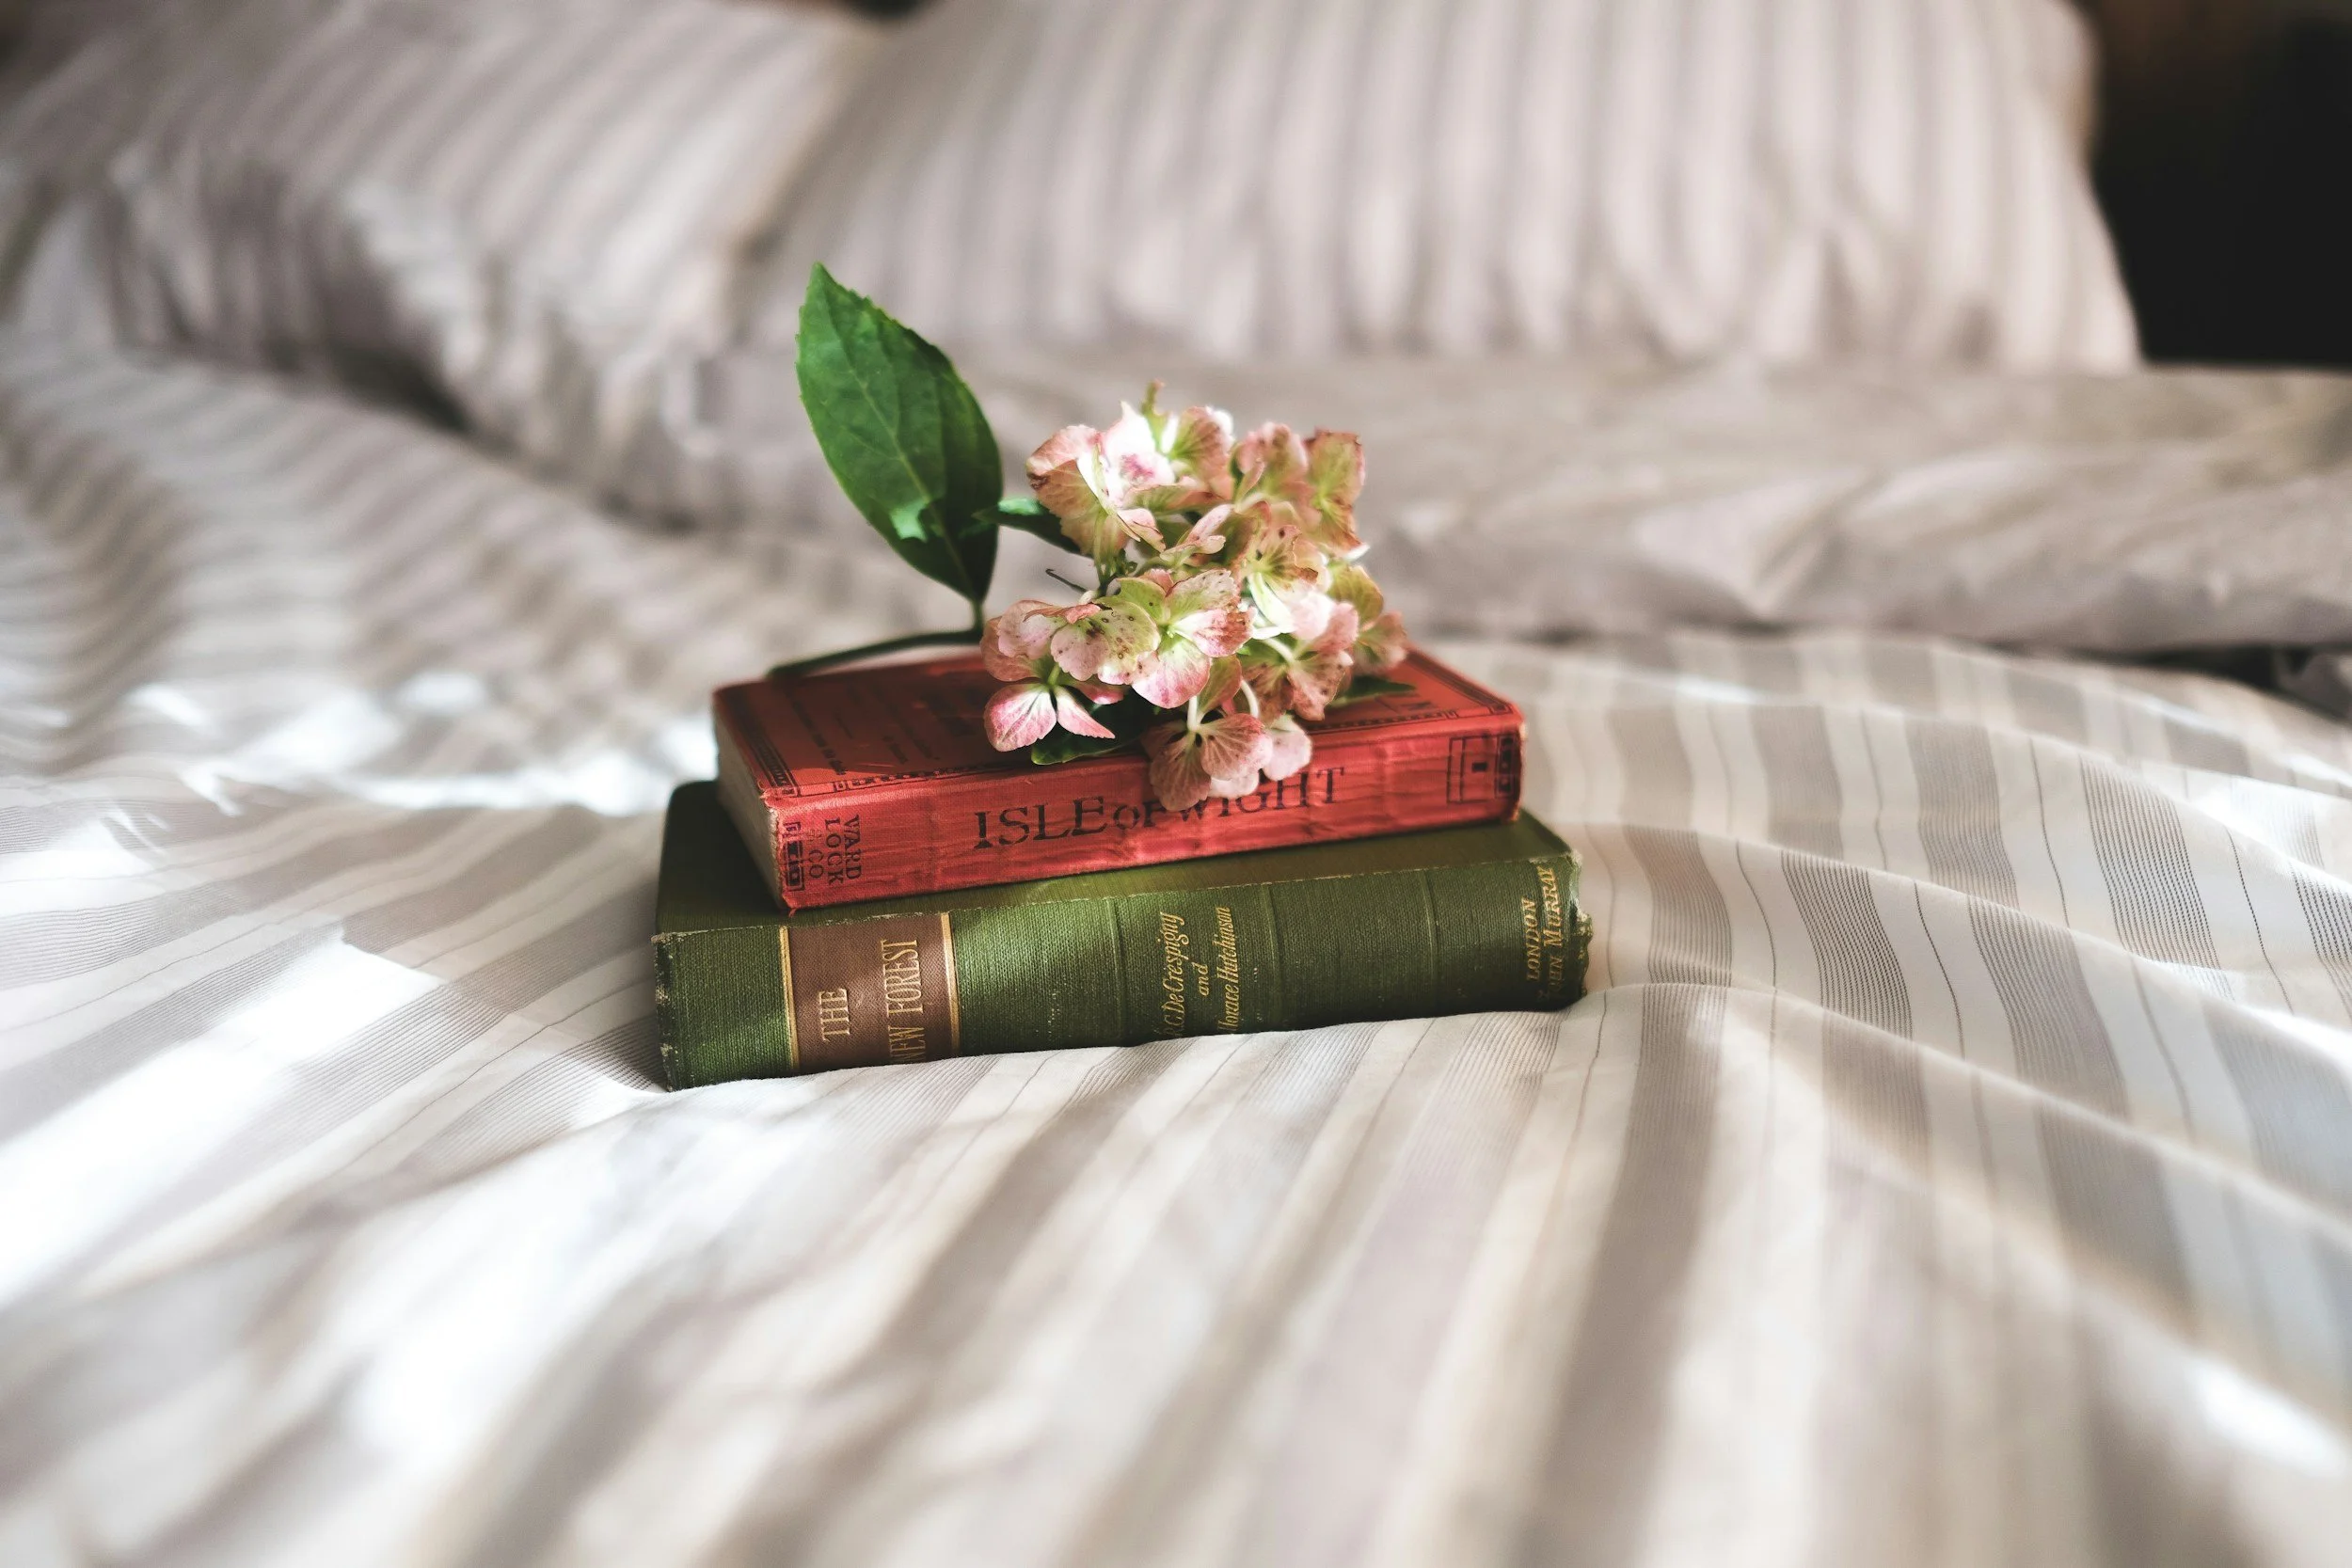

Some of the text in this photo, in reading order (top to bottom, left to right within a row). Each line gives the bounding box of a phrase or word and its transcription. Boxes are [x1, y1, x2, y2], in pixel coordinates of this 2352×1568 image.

[824, 817, 845, 886] LOCK
[844, 814, 862, 880] WARD
[973, 796, 1108, 850] ISLE
[1212, 908, 1239, 983] Hutchinson
[1520, 895, 1541, 982] LONDON
[880, 940, 928, 1065] NEW FOREST
[1191, 961, 1210, 997] and
[818, 987, 851, 1042] THE
